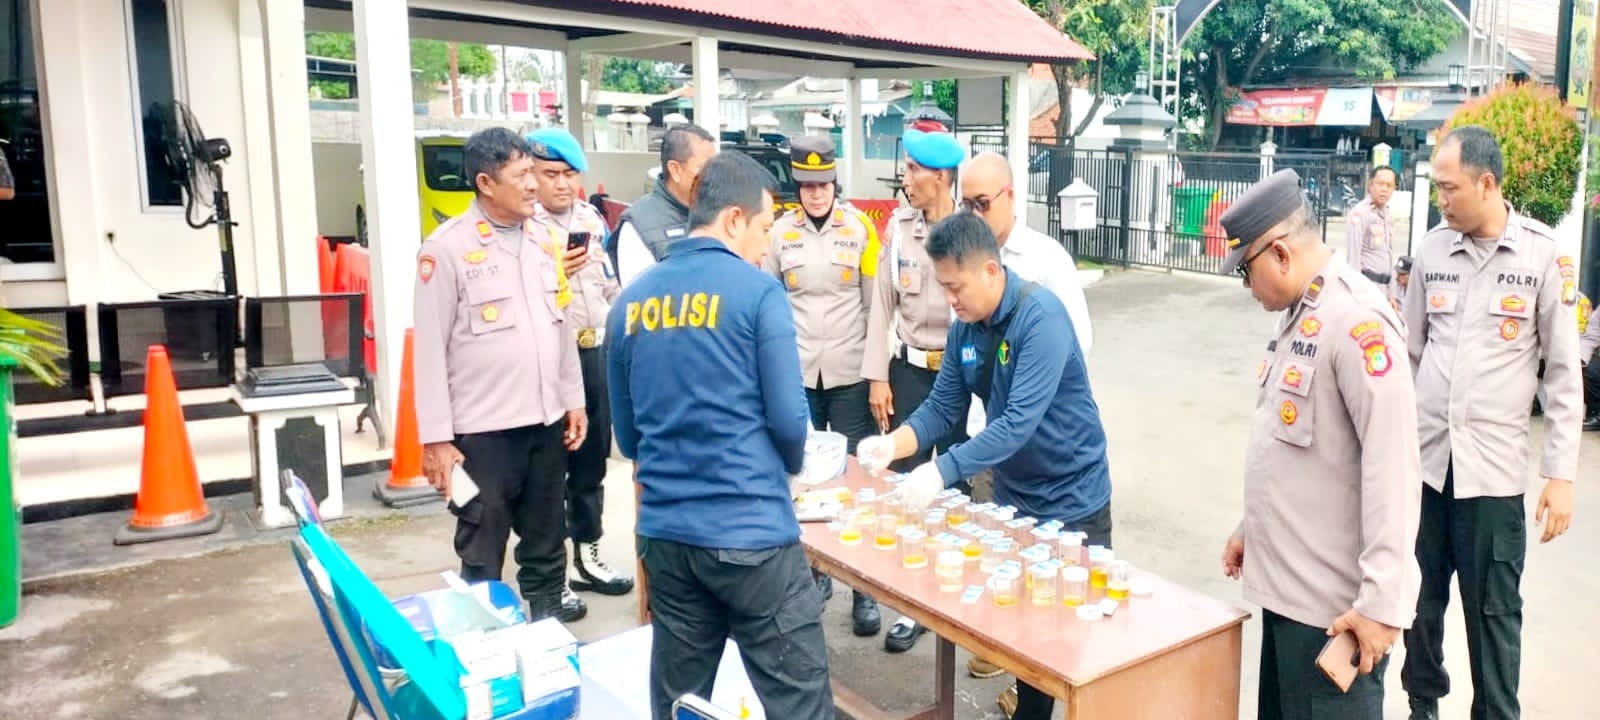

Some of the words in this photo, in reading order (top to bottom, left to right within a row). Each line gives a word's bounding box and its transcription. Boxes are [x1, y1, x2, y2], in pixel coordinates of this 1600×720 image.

[1425, 272, 1460, 284] SARWANI
[1497, 272, 1538, 288] POLRI
[624, 292, 720, 336] POLISI
[1291, 339, 1318, 358] POLRI
